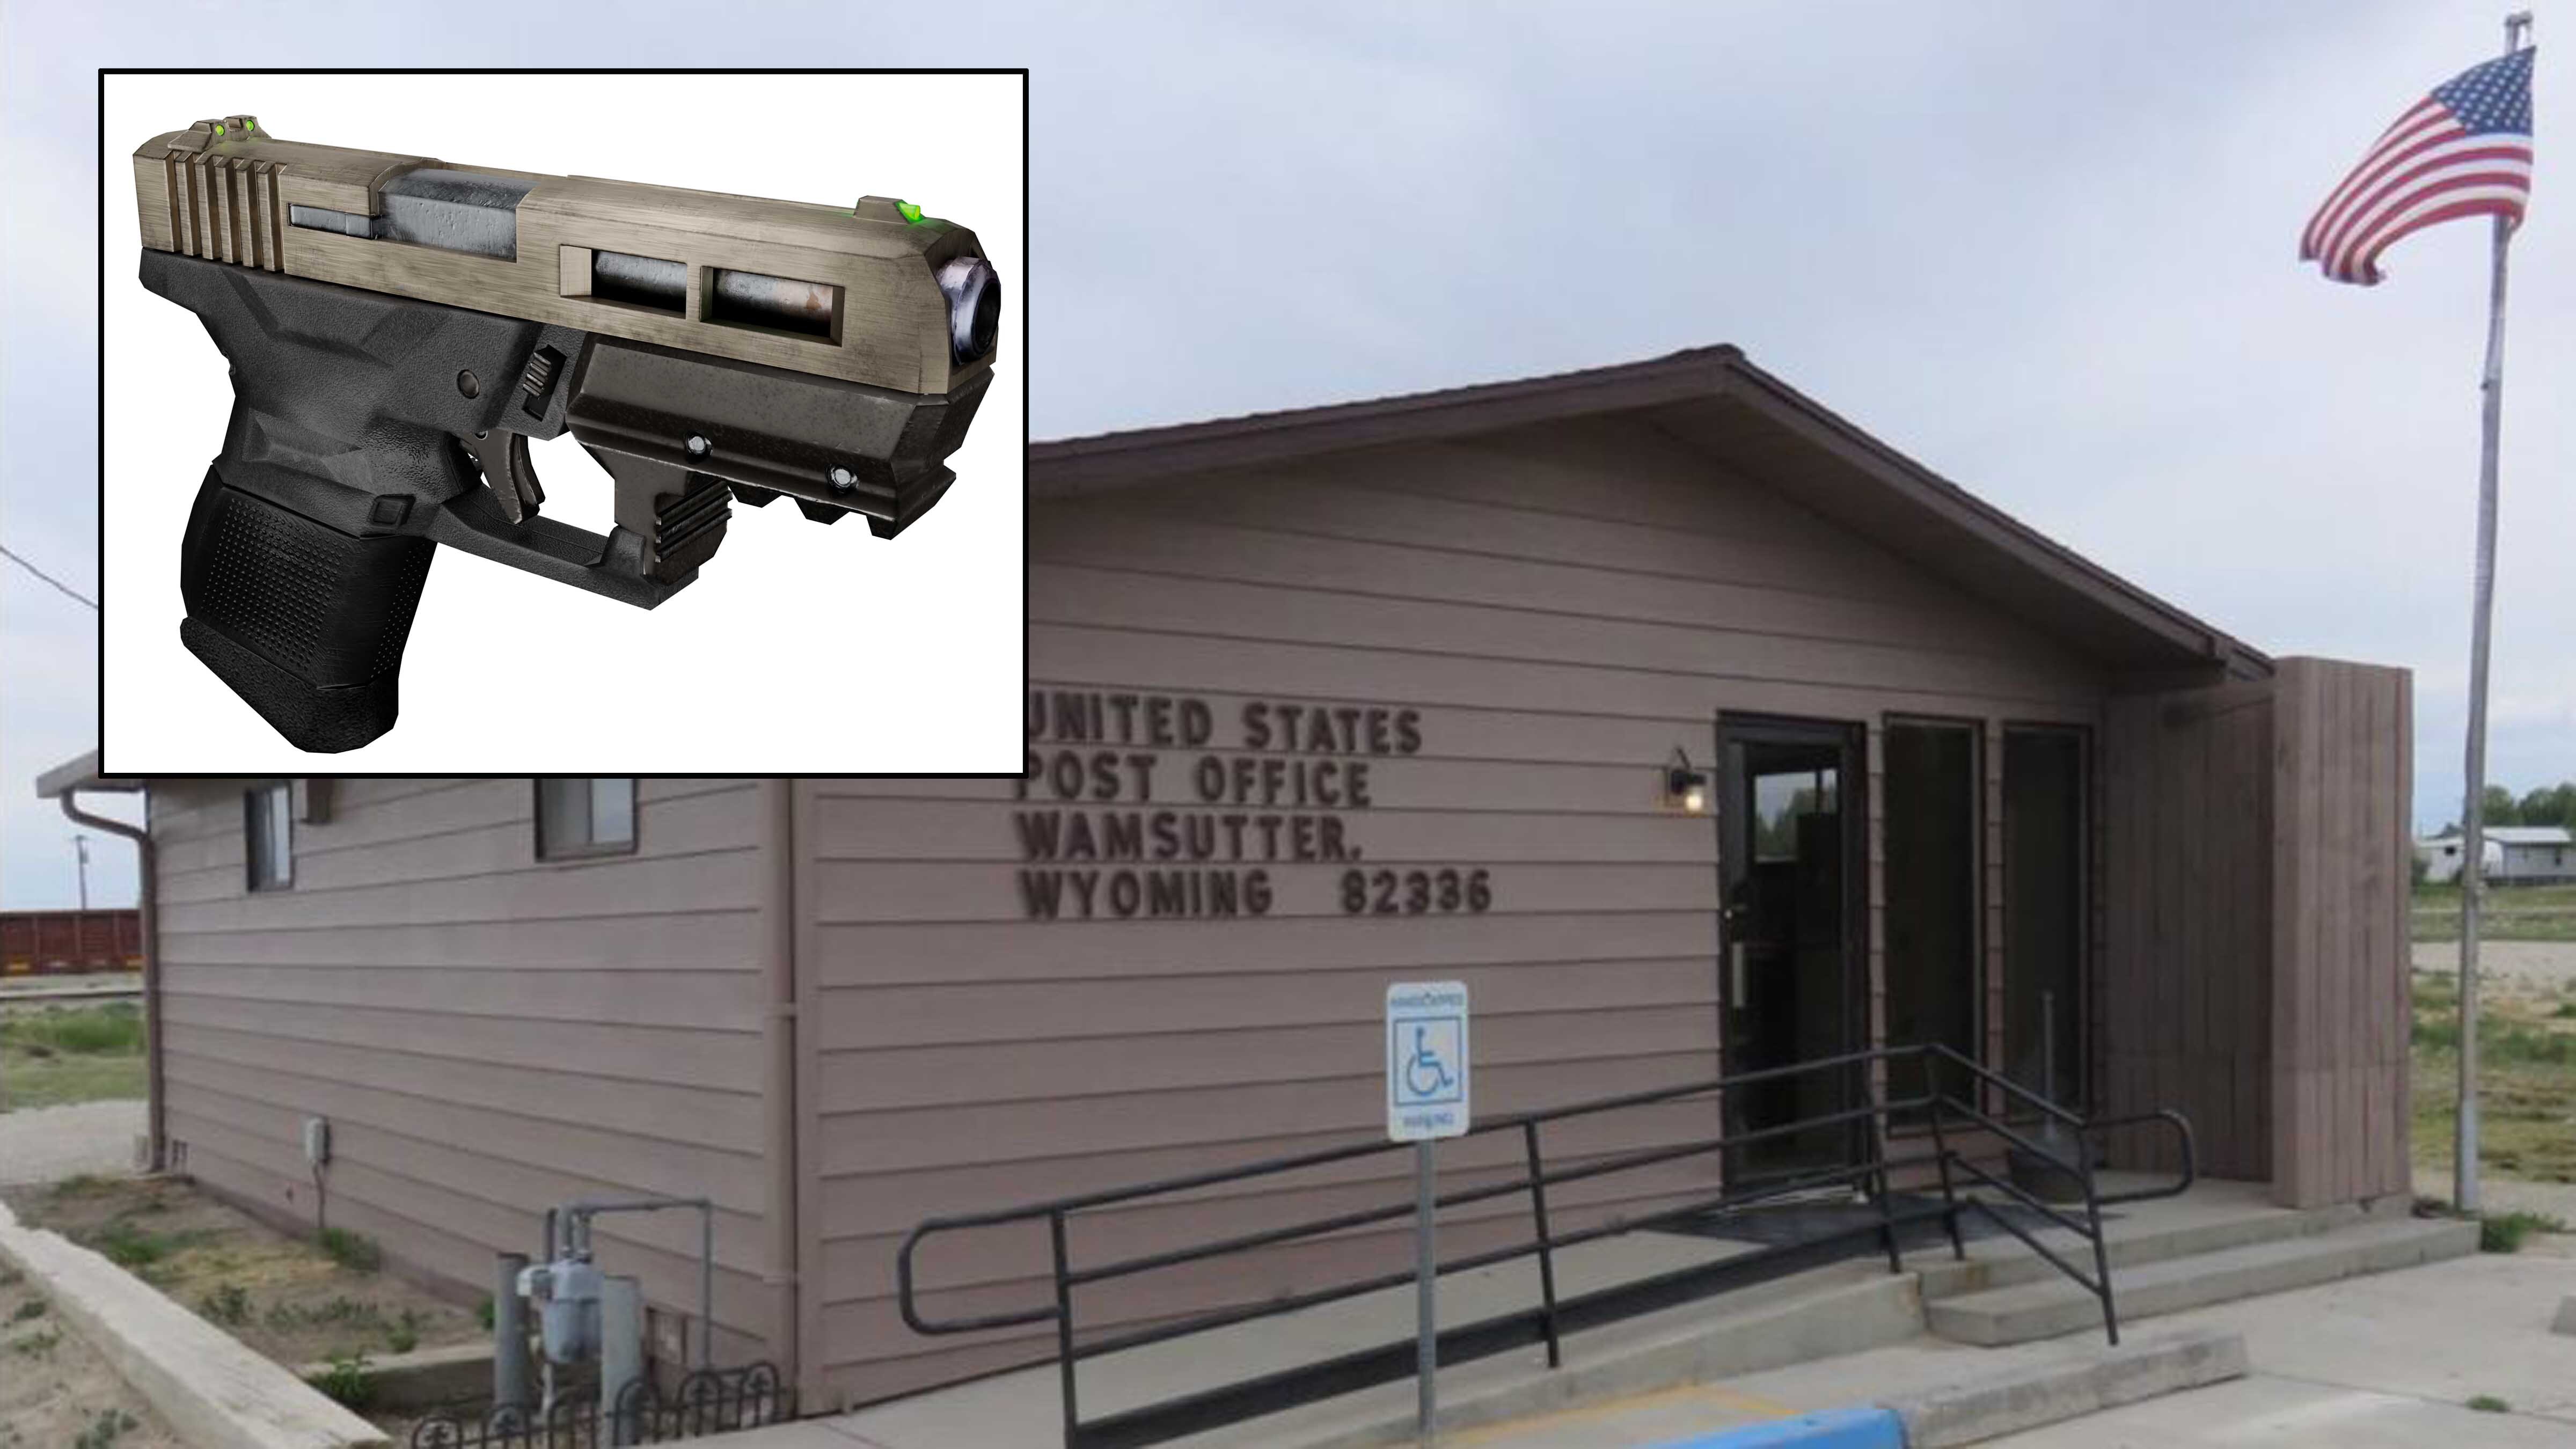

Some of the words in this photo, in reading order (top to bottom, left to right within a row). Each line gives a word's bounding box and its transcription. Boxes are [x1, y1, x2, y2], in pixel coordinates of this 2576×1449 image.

[1241, 702, 1422, 753] STATES
[1197, 756, 1371, 806] OFFICE
[1018, 868, 1273, 918] WYOMING
[1342, 868, 1491, 912] 82336
